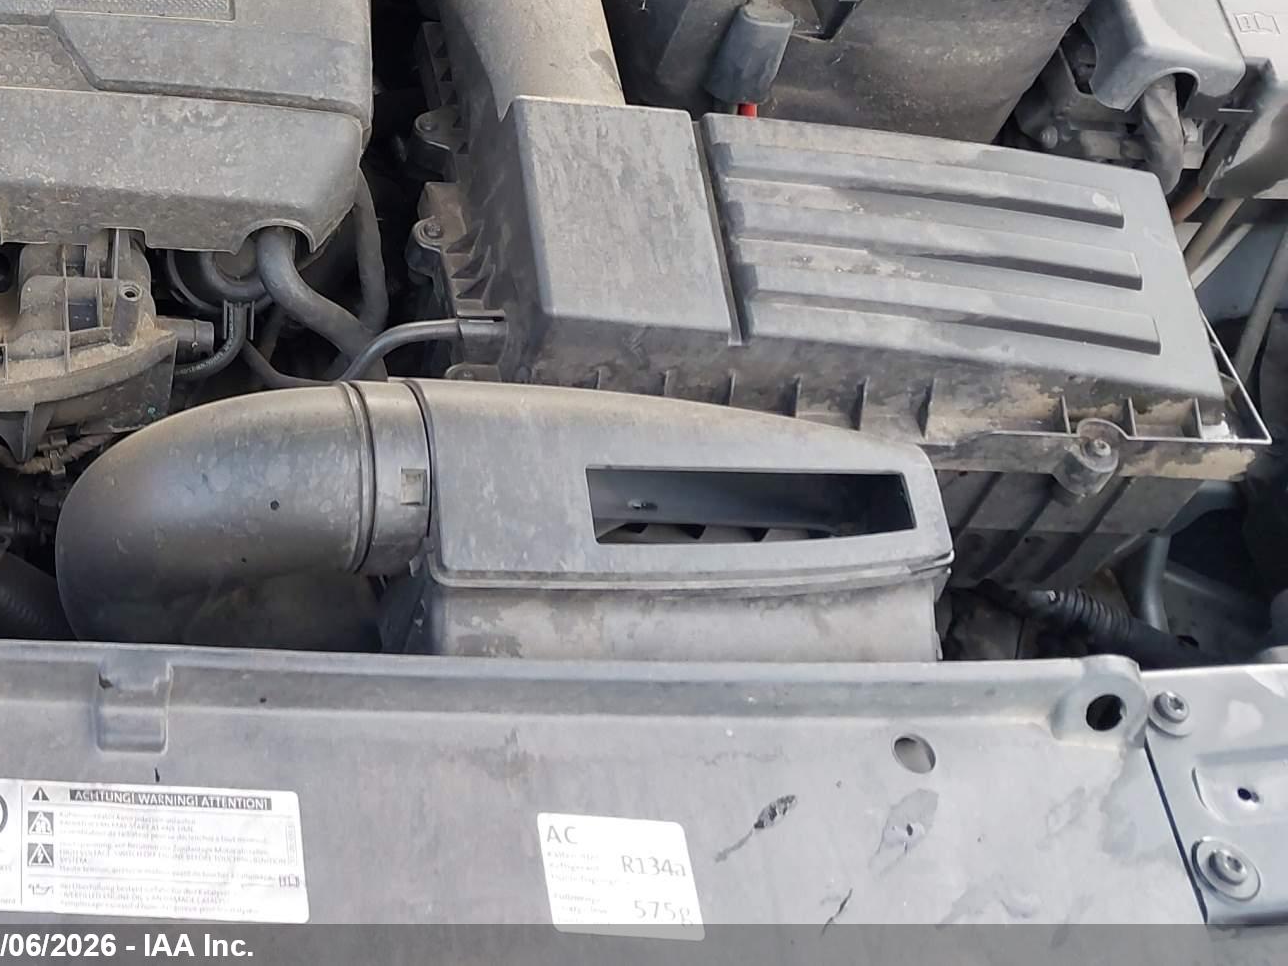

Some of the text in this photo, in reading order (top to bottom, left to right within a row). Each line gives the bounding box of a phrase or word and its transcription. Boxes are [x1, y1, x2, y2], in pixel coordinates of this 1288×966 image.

[74, 790, 268, 810] ACHTUNG! WARNING! ATTENTION!
[547, 825, 579, 845] AC
[621, 855, 687, 877] R134a
